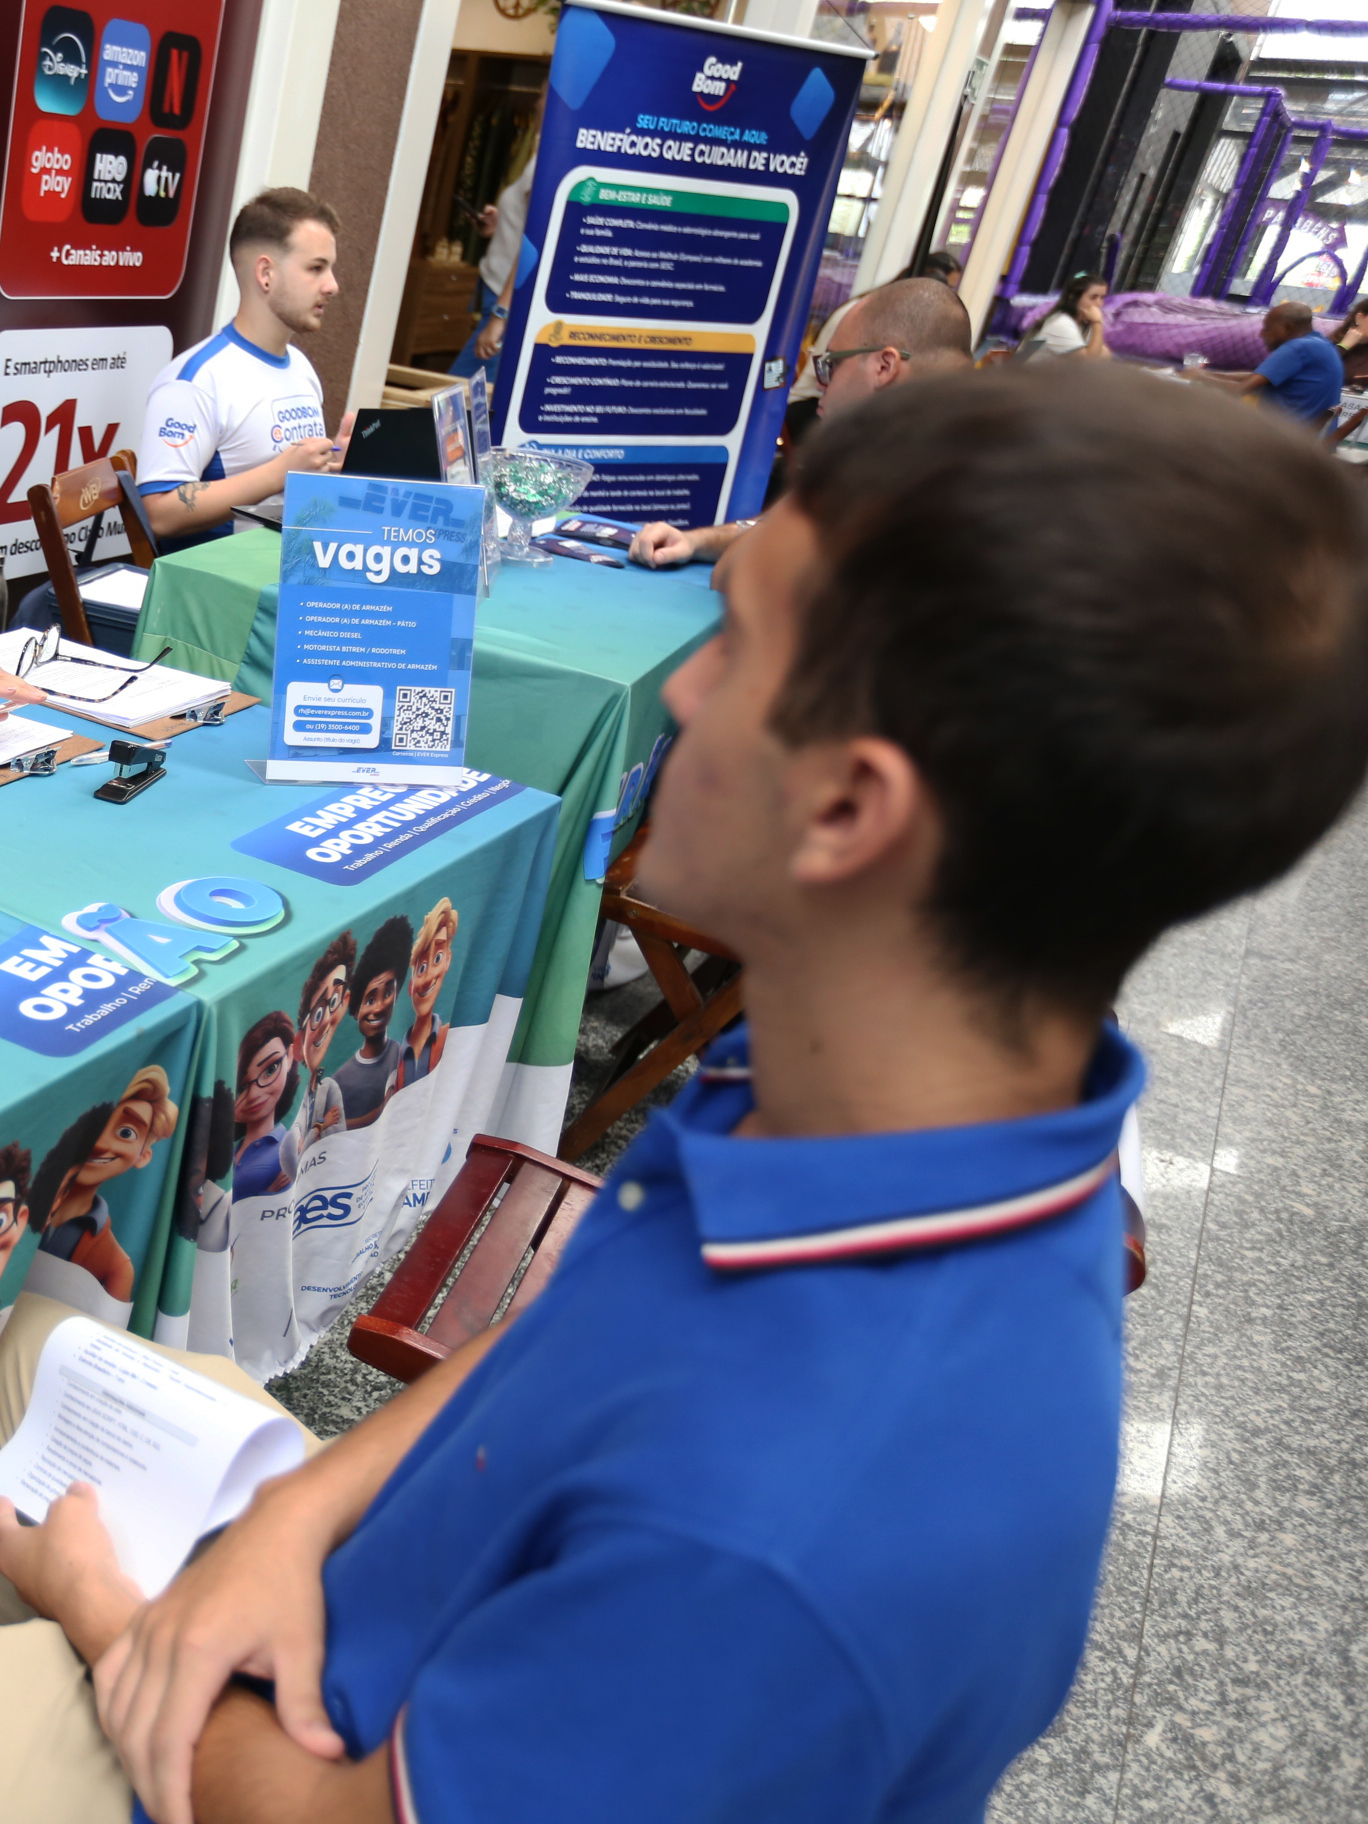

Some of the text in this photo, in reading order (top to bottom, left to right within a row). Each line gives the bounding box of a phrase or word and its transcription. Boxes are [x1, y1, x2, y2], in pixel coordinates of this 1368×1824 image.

[103, 42, 146, 67] amazon
[105, 66, 139, 88] prime
[703, 56, 742, 81] Good
[692, 72, 726, 96] Bom
[636, 114, 657, 130] SEU
[658, 117, 698, 136] FUTURO
[699, 123, 740, 143] COMEÇA
[31, 147, 71, 173] globo
[576, 127, 808, 175] BENEFÍCIOS QUE CUIDAM DE VOCÊ!
[94, 153, 128, 182] HBO
[40, 171, 72, 198] play
[91, 180, 124, 200] max
[61, 244, 100, 266] Canais
[102, 249, 117, 266] ao
[118, 246, 143, 267] vivo
[4, 351, 127, 378] E smartphones em até
[159, 427, 185, 440] Bom
[165, 417, 197, 434] Good
[362, 482, 455, 528] EVER
[382, 526, 436, 544] TEMOS
[313, 541, 442, 584] vagas
[306, 601, 341, 610] OPERADOR
[342, 603, 351, 611] (A)
[362, 604, 393, 612] ARMAZÉM
[305, 616, 340, 624] OPERADOR
[361, 618, 392, 627] ARMAZÉM
[397, 620, 417, 628] PÁTIO
[304, 629, 339, 638] MECÂNICO
[303, 644, 341, 652] MOTORISTA
[302, 658, 341, 666] ASSISTENTE
[341, 660, 397, 669] ADMINISTRATIVO
[407, 663, 438, 671] ARMAZÉM
[303, 694, 322, 703] Envie
[336, 695, 367, 704] currículo
[298, 707, 370, 718] rh@everexpress.com.br
[314, 723, 327, 731] (19)
[327, 723, 360, 731] 3500-6400
[355, 766, 378, 775] EVER
[343, 790, 490, 871] Trabalho Renda Qualificação Crédito
[65, 996, 128, 1033] Trabalho
